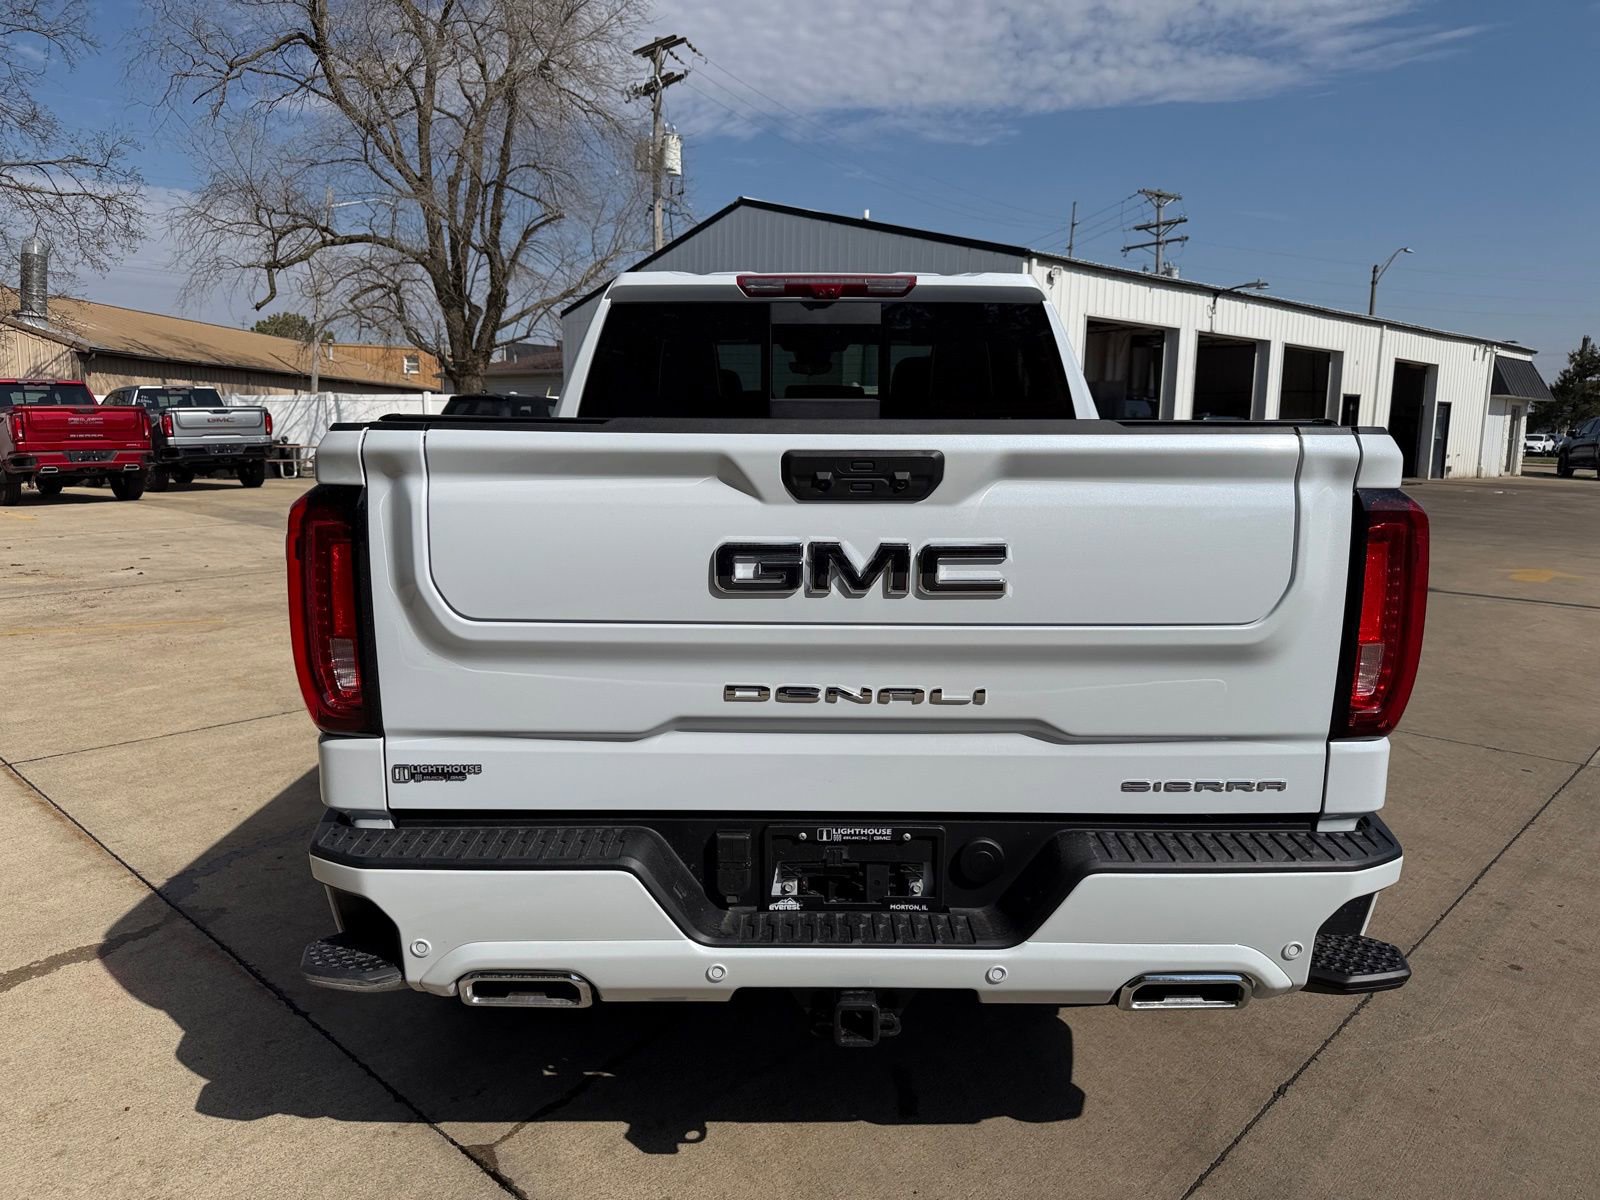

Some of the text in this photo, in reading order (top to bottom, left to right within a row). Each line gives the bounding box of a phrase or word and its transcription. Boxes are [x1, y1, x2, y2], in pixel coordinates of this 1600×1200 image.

[711, 541, 1008, 597] GMC
[724, 685, 987, 706] DENALI
[411, 764, 482, 773] LIGHTHOUSE
[1121, 779, 1287, 792] SIERRA
[769, 903, 800, 911] everest
